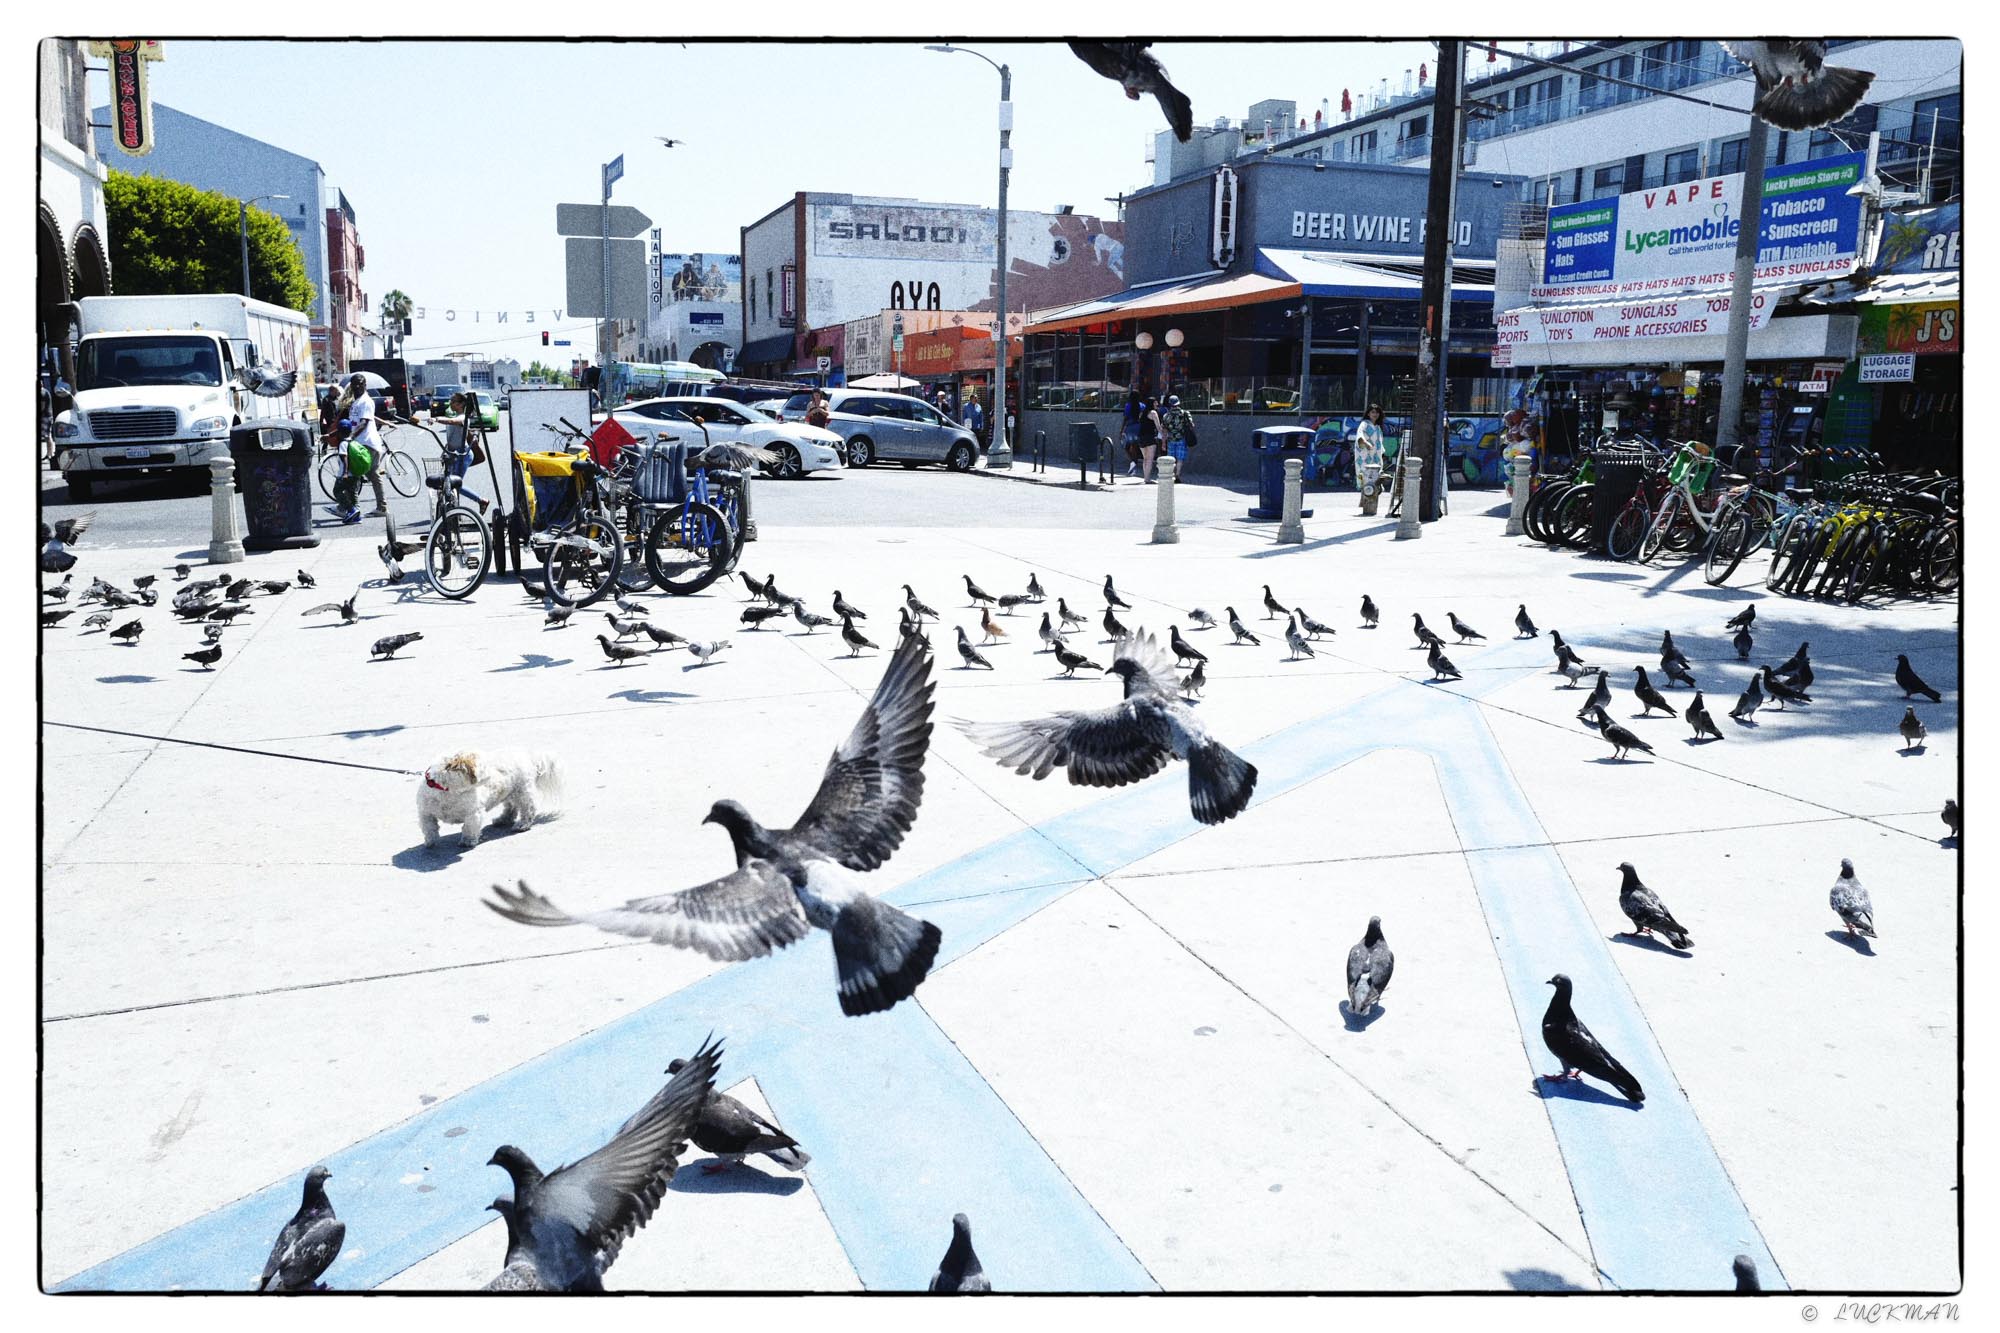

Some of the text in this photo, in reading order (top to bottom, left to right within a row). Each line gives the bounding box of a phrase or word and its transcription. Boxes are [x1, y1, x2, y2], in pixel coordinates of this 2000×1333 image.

[1765, 167, 1854, 192] Lucky Venice Store #3
[1644, 180, 1723, 209] VAPE
[1771, 197, 1826, 218] Tobacco
[1292, 210, 1347, 240] BEER
[1353, 214, 1411, 243] WINE
[1552, 211, 1611, 229] Lucky Venice Store #3
[1768, 218, 1839, 240] Sunscreen
[1556, 230, 1609, 249] Sun Glasses
[1625, 215, 1741, 254] Lycamobile
[1668, 247, 1682, 255] Call
[1682, 246, 1693, 254] the
[1694, 243, 1713, 252] world
[1714, 241, 1724, 249] for
[1758, 241, 1837, 263] ATM Available
[652, 230, 660, 302] TATTOO
[1555, 253, 1575, 267] Hats
[1531, 286, 1575, 297] SUNGLASS
[1577, 284, 1618, 295] SUNGLASS
[1621, 282, 1644, 293] HATS
[1645, 279, 1669, 290] HATS
[1671, 275, 1696, 287] HATS
[1698, 272, 1726, 285] HATS
[1788, 258, 1851, 275] SUNGLASS
[891, 281, 940, 310] AYA
[1497, 315, 1519, 327] HATS
[1540, 311, 1594, 325] SUNLOTION
[1621, 303, 1678, 320] SUNGLASS
[1916, 309, 1956, 342] J'S
[1549, 328, 1573, 340] TOY'S
[1594, 325, 1630, 338] PHONE
[1634, 319, 1708, 337] ACCESSORIES
[1863, 355, 1911, 367] LUGGAGE
[1862, 369, 1910, 379] STORAGE
